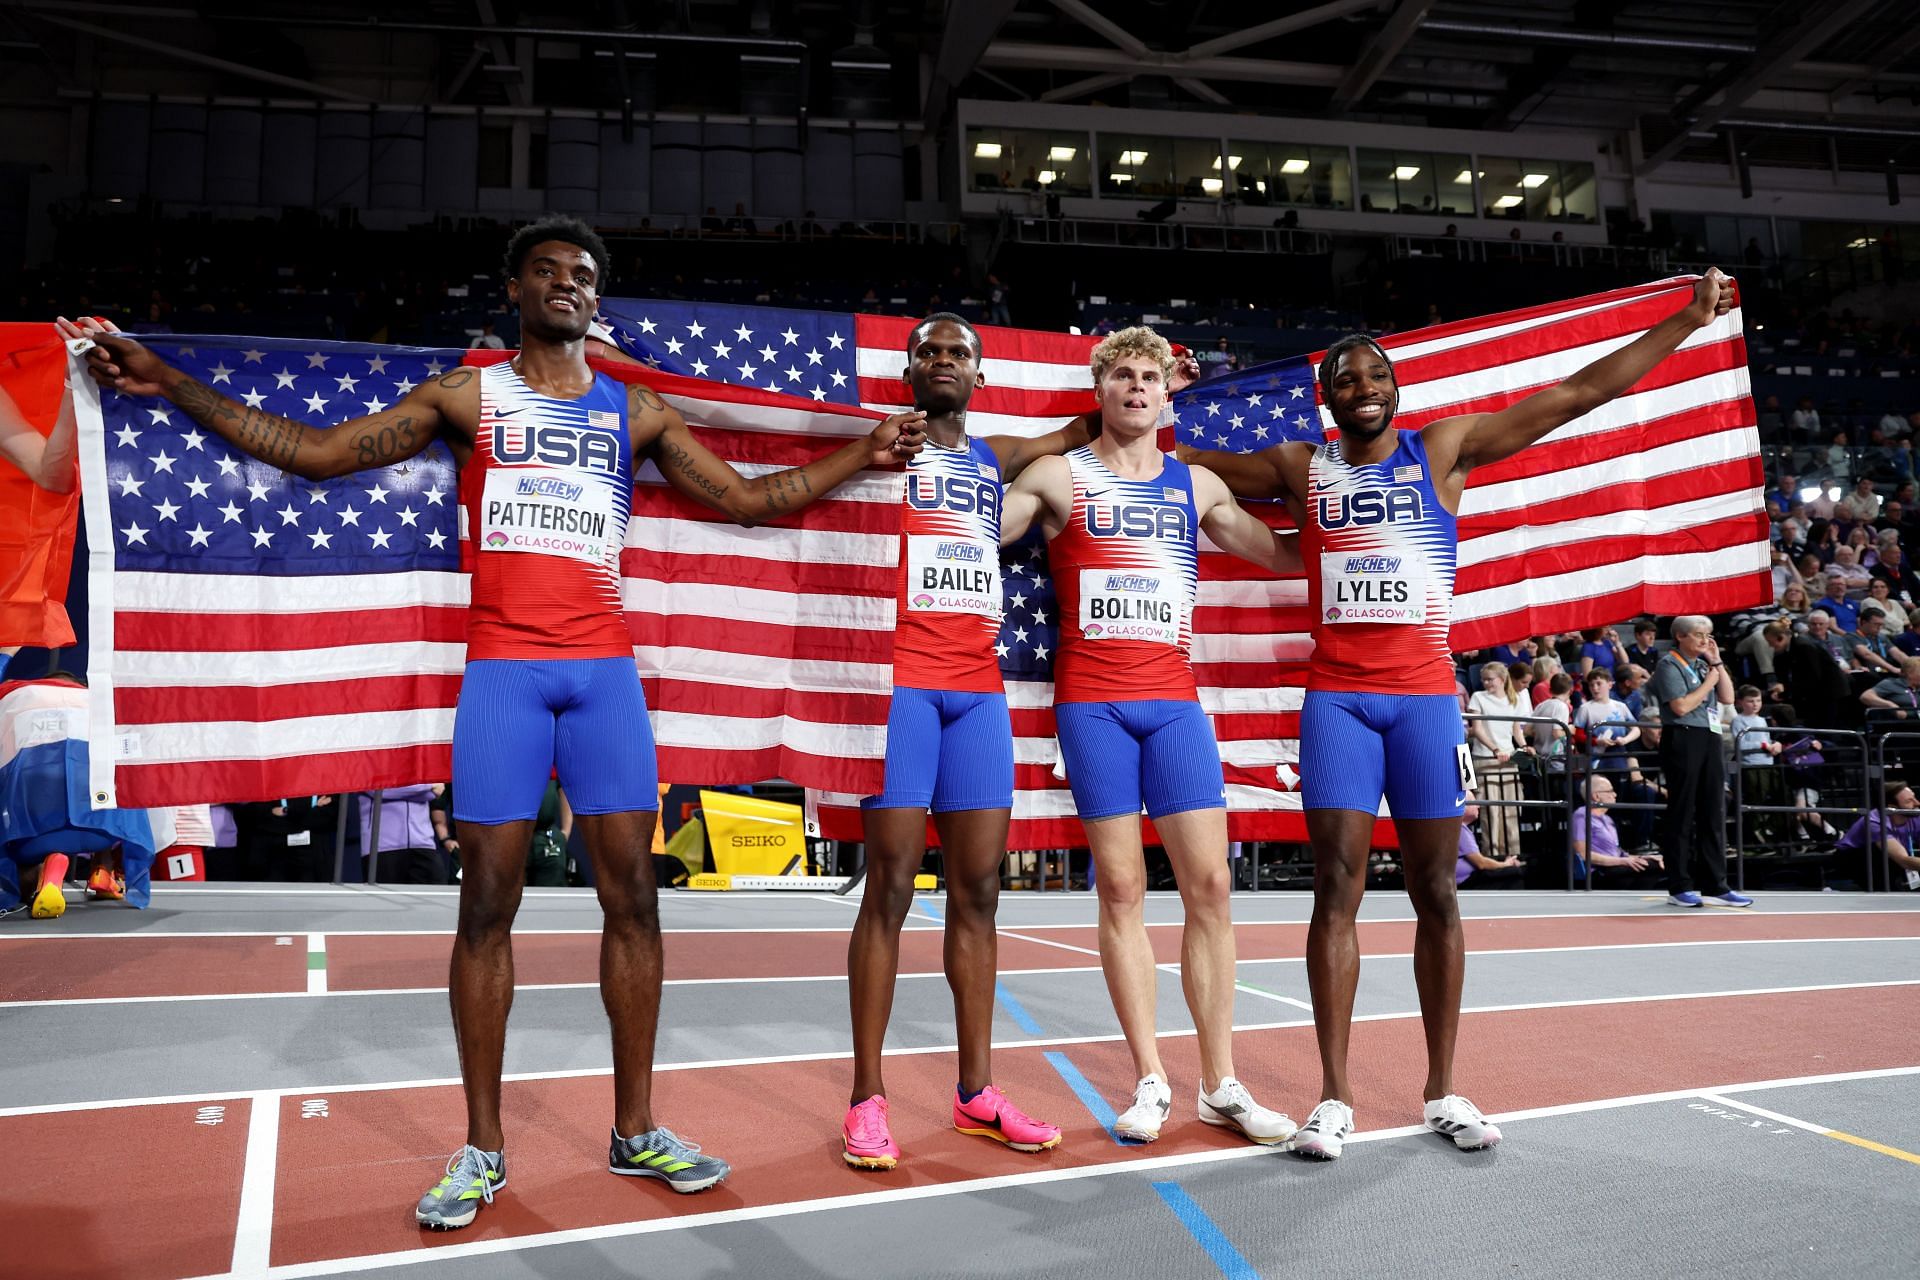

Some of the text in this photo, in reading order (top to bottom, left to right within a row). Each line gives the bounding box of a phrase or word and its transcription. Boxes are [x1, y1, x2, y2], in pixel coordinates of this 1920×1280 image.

[358, 417, 417, 465] 803
[492, 424, 619, 473] USA
[667, 442, 729, 499] Blessed
[907, 474, 998, 523] USA
[1318, 486, 1423, 531] USA
[489, 501, 606, 538] PATTERSON
[1086, 503, 1187, 542] USA
[514, 535, 601, 557] GLASGOW 24
[923, 567, 993, 594] BAILEY
[1337, 580, 1408, 603] LYLES
[939, 597, 997, 611] GLASGOW 24
[1091, 598, 1172, 623] BOLING
[1345, 609, 1422, 619] GLASGOW 24
[1107, 625, 1175, 640] GLASGOW 24
[731, 835, 786, 848] SEIKO
[176, 859, 185, 874] 1
[695, 879, 727, 887] SEIKO
